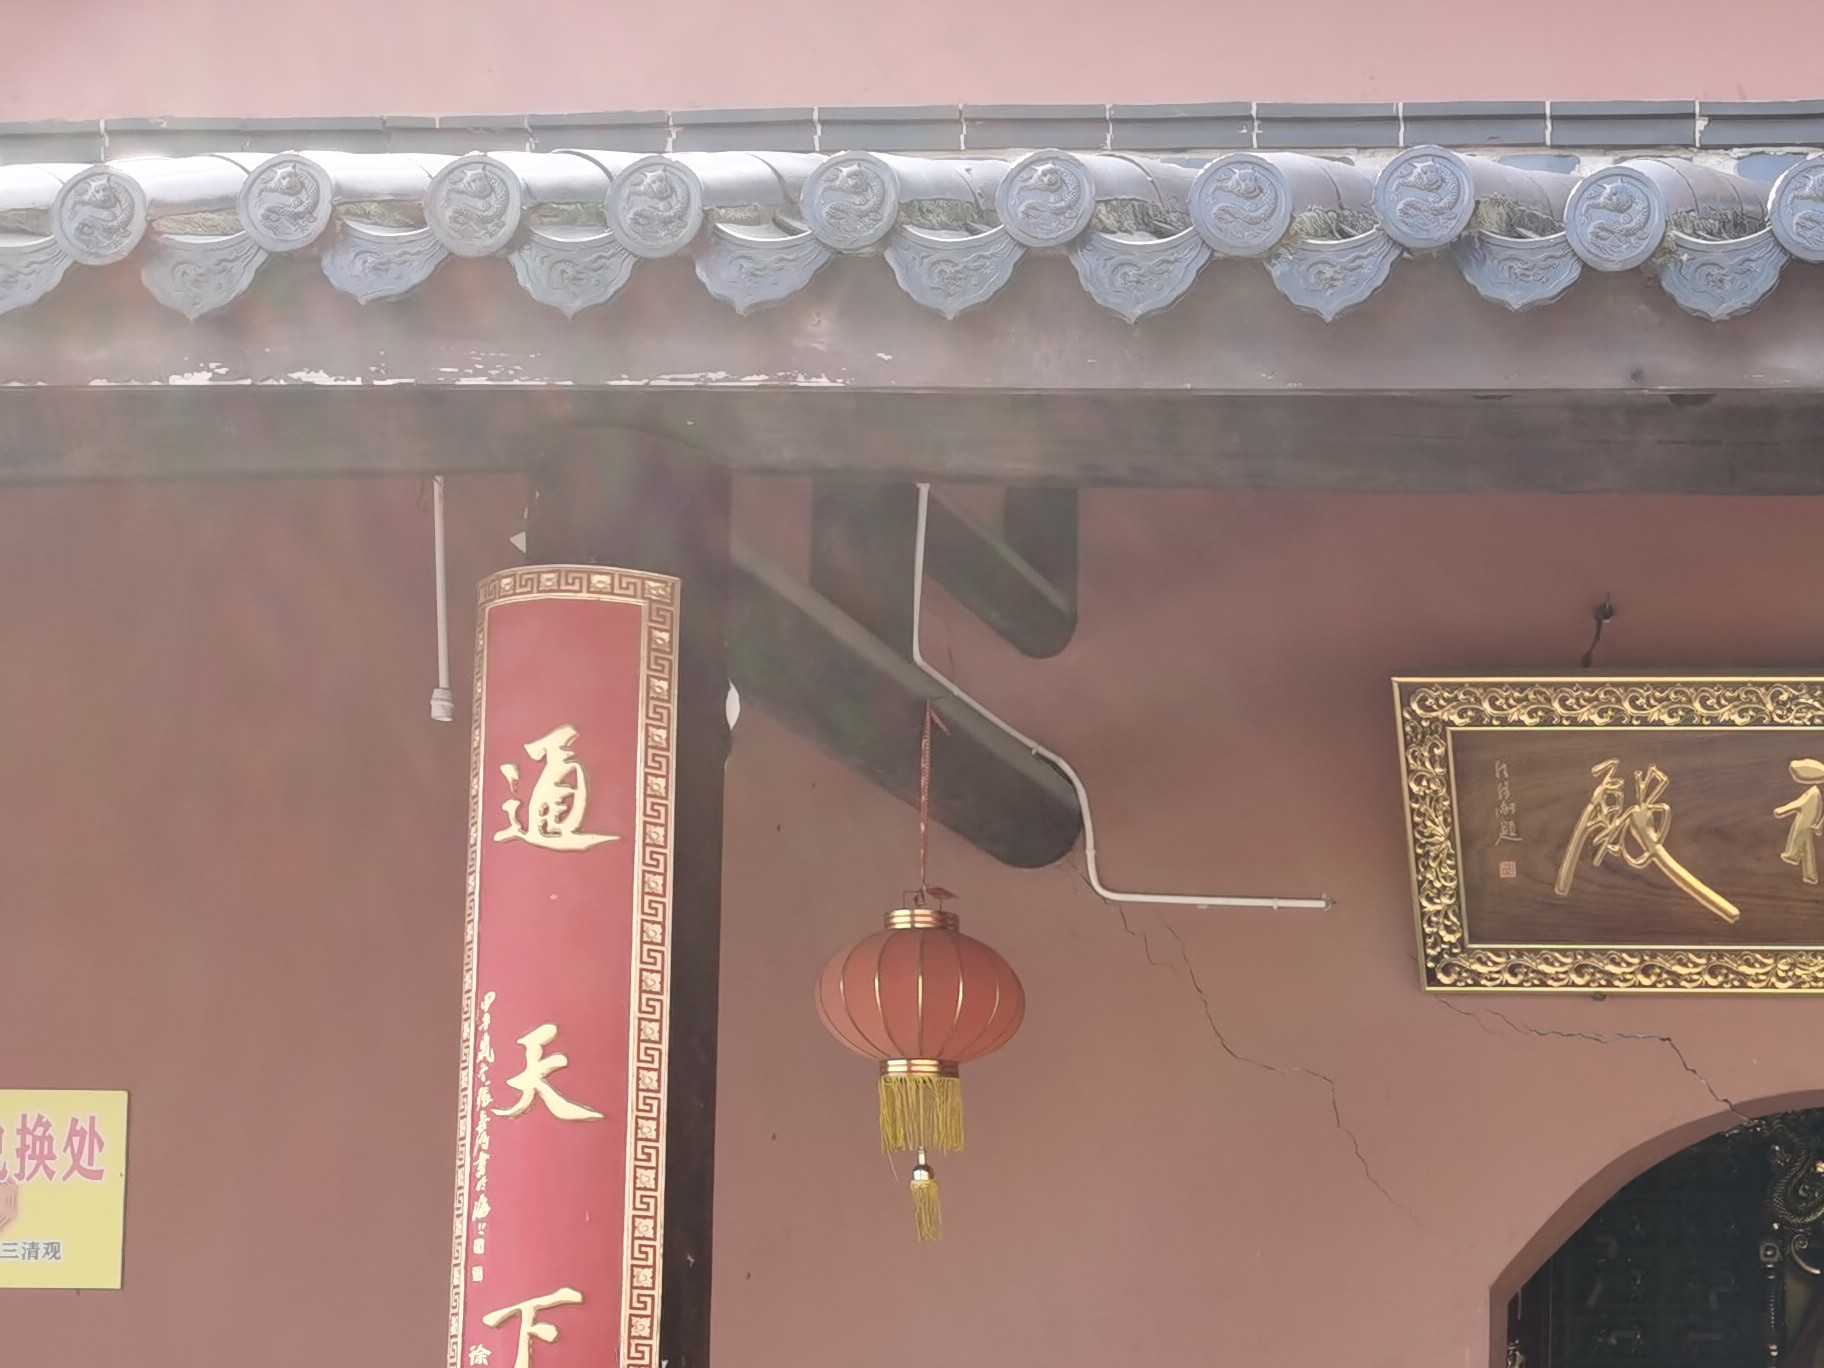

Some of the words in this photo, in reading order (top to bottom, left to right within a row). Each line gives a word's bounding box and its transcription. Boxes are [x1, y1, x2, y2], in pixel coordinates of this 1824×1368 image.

[0, 1112, 105, 1182] 换处
[0, 1241, 62, 1262] 三清观
